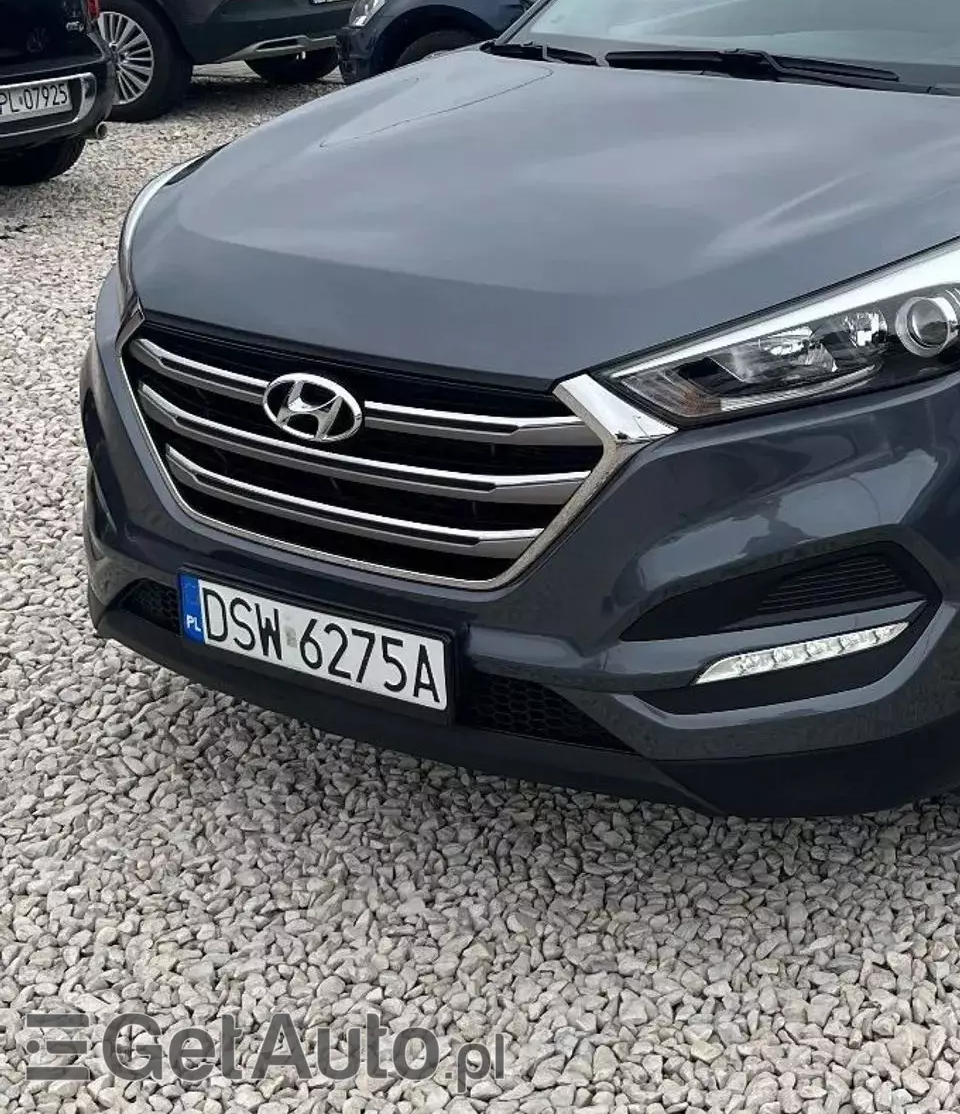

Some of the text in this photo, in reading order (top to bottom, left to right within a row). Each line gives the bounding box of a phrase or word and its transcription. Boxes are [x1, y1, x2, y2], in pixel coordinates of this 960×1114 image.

[23, 83, 68, 111] 07925
[186, 614, 202, 632] PL
[202, 587, 441, 703] DSW 6275A
